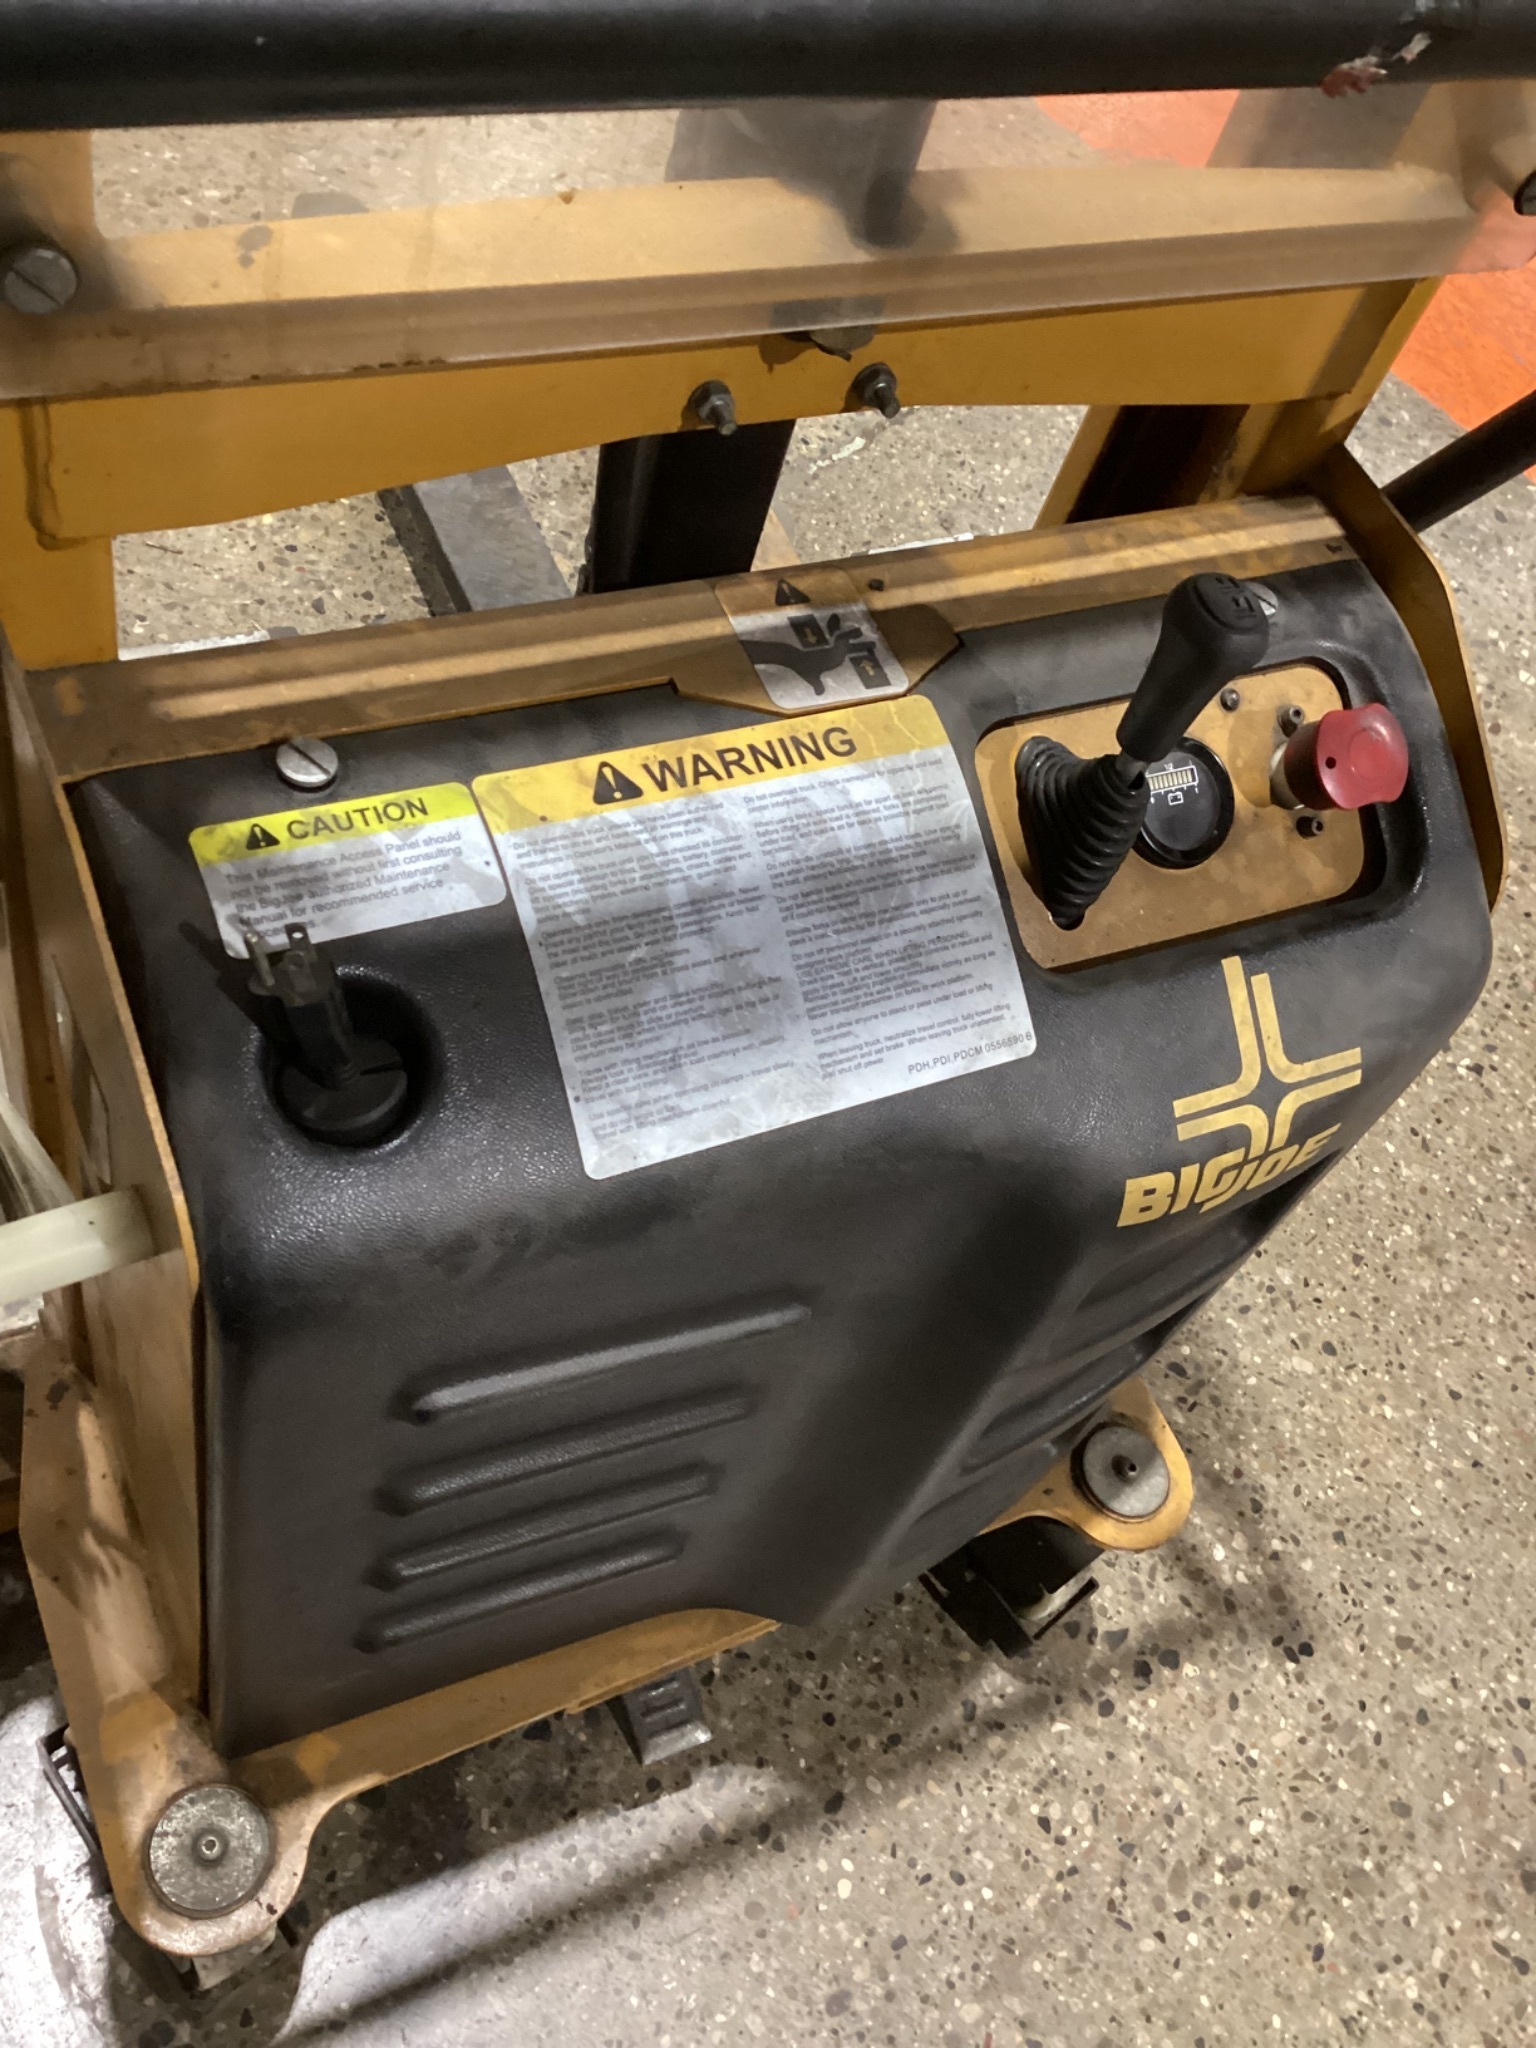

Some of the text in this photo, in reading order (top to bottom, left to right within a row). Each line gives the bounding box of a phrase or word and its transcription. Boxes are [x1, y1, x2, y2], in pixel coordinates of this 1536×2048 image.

[641, 726, 858, 795] WARNING
[287, 797, 429, 841] CAUTION
[331, 862, 376, 879] without
[377, 857, 401, 870] first
[402, 846, 463, 867] consulting
[338, 845, 383, 862] Access
[384, 839, 420, 854] Panel
[421, 831, 462, 847] should
[306, 878, 372, 898] authorized
[373, 863, 450, 885] Maintenance
[288, 905, 307, 917] for
[309, 887, 399, 913] recommended
[400, 879, 445, 895] service
[874, 948, 897, 959] WHEN
[951, 1024, 968, 1033] truck
[984, 1031, 1025, 1054] 0556590
